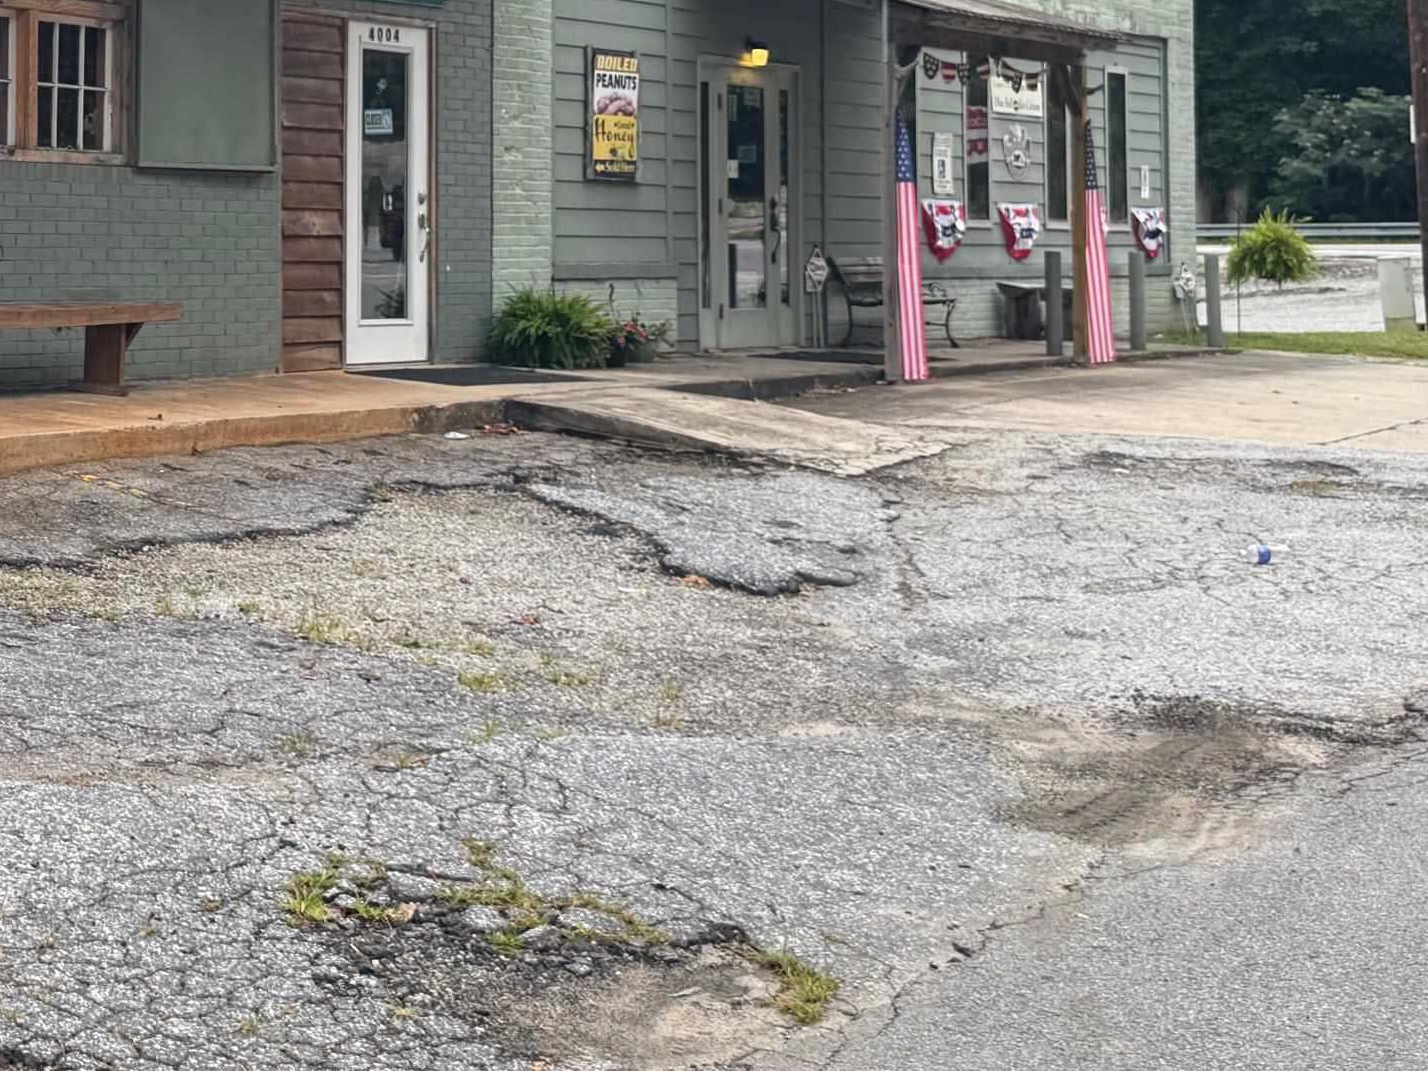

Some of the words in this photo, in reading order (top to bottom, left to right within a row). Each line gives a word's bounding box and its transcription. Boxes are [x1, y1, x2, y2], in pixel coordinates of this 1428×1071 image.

[369, 27, 400, 42] 4004
[596, 73, 637, 90] PEANUTS
[595, 116, 635, 158] Honey
